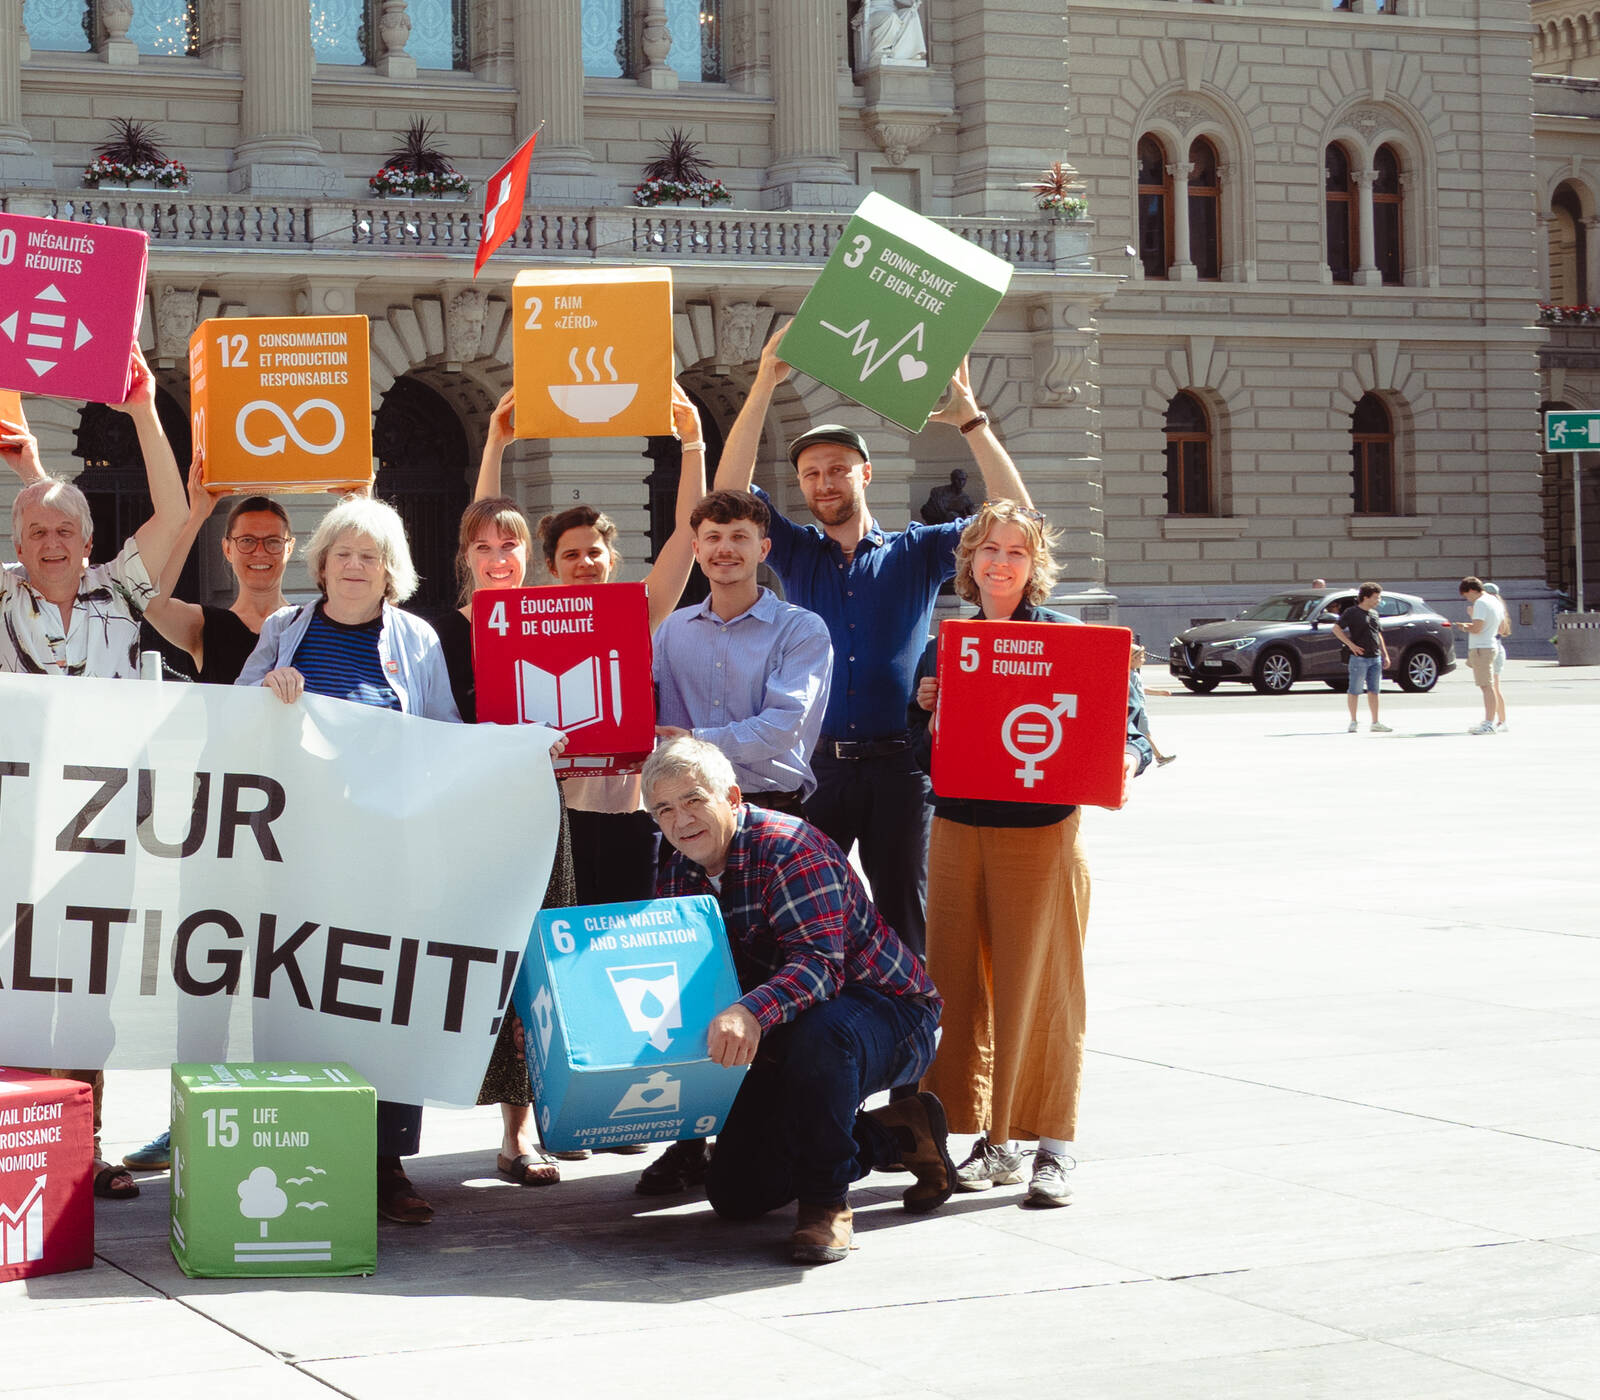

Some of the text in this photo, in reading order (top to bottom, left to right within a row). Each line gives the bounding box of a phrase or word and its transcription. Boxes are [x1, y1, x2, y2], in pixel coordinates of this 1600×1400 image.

[28, 230, 95, 254] INÉGALITÉS
[843, 235, 872, 268] 3
[25, 251, 82, 275] RÉDUITES
[879, 248, 958, 298] BONNE SANTÉ
[869, 267, 945, 315] ET BIEN-ÊTRE
[554, 296, 582, 309] FAIM
[524, 297, 543, 330] 2
[554, 312, 598, 329] «ZÉRO»
[259, 332, 347, 348] CONSOMMATION
[216, 334, 249, 368] 12
[259, 352, 347, 367] ET PRODUCTION
[260, 371, 348, 387] RESPONSABLES
[572, 489, 580, 500] 3
[521, 596, 593, 614] ÉDUCATION
[488, 601, 509, 637] 4
[522, 615, 594, 635] DE QUALITÉ
[959, 637, 980, 672] 5
[993, 638, 1044, 655] GENDER
[992, 659, 1053, 676] EQUALITY
[55, 765, 286, 863] ZUR
[584, 910, 673, 932] CLEAN WATER
[551, 919, 576, 954] 6
[589, 928, 697, 951] AND SANITATION
[22, 1102, 63, 1122] DÉCENT
[253, 1108, 278, 1124] LIFE
[202, 1108, 240, 1147] 15
[574, 1118, 685, 1137] ASSAINISSEMENT
[693, 1115, 717, 1134] 6
[253, 1131, 309, 1147] ON LAND
[580, 1128, 680, 1146] EAU PROPRE ET
